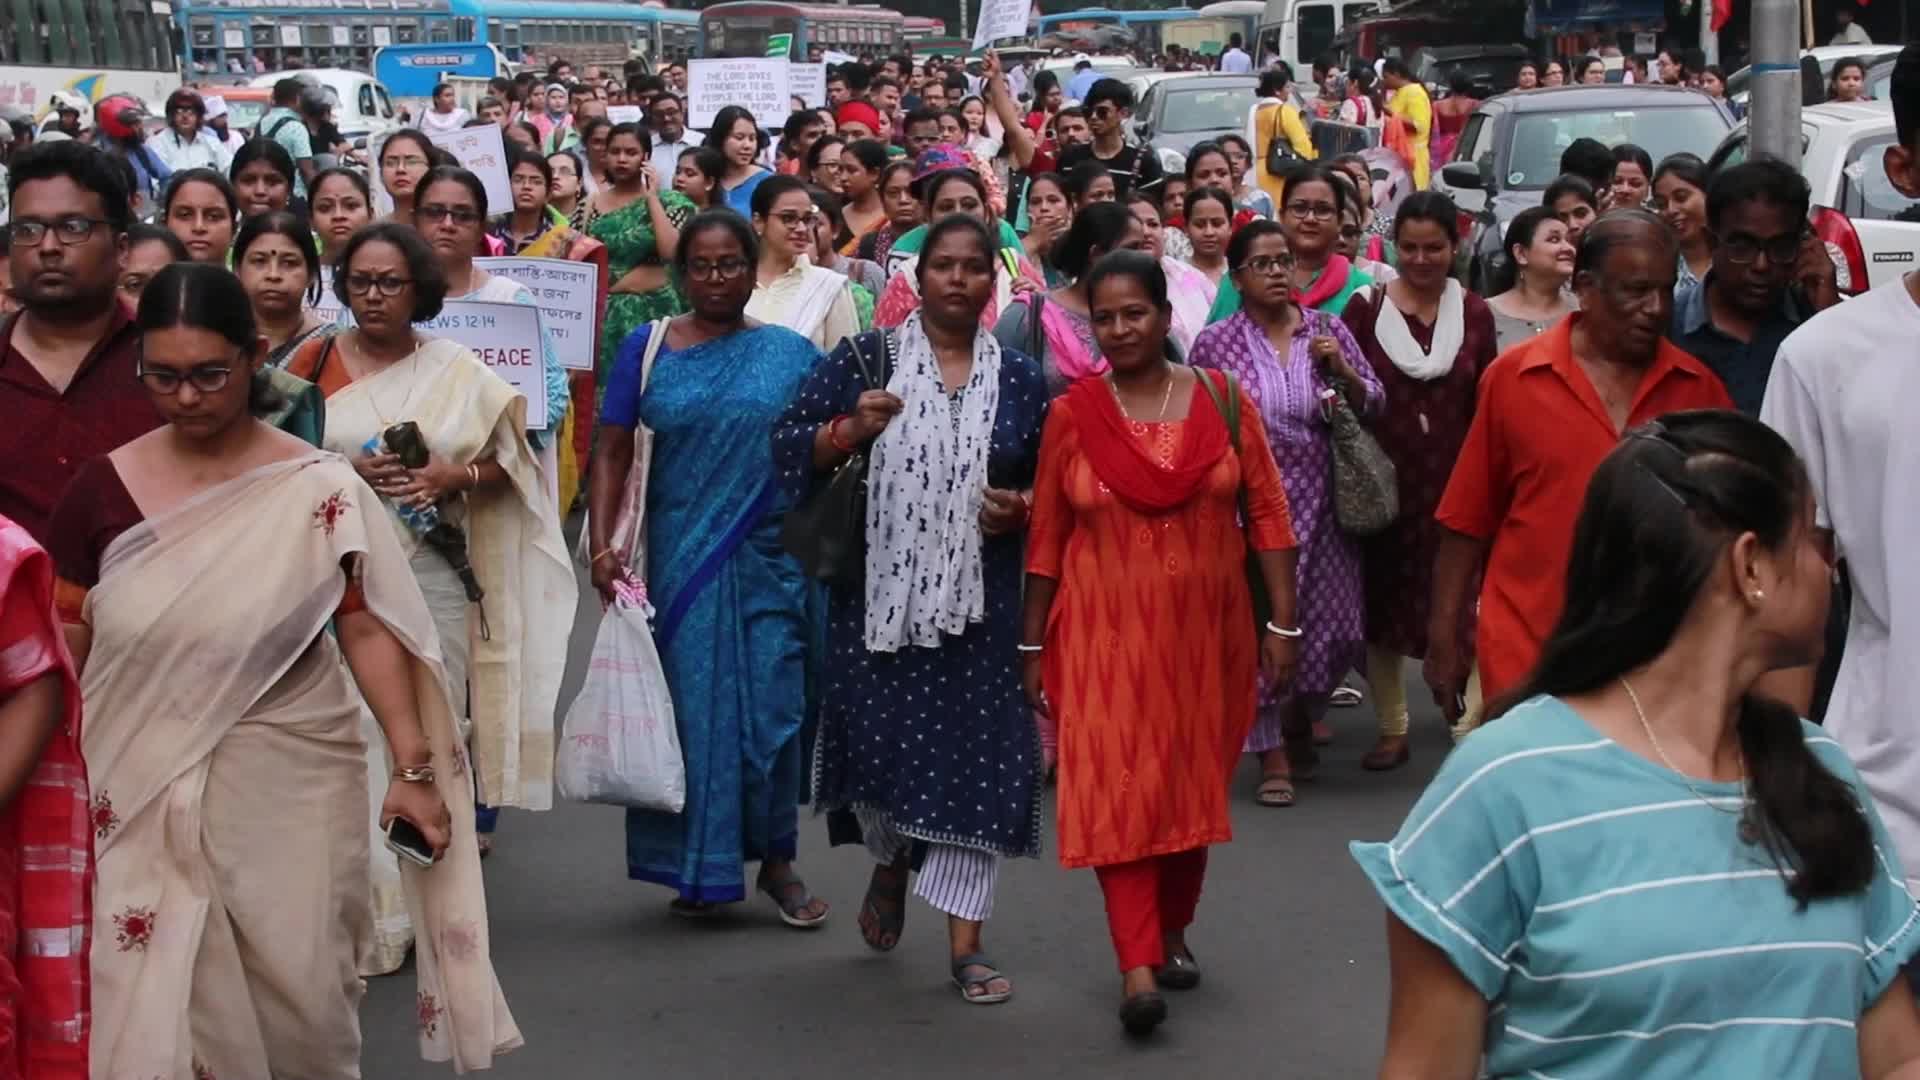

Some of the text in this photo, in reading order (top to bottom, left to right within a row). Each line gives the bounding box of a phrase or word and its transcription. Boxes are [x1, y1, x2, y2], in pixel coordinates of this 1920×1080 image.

[706, 72, 722, 81] THE
[723, 72, 746, 81] LORD
[737, 92, 753, 101] THE
[465, 315, 496, 329] 12:14
